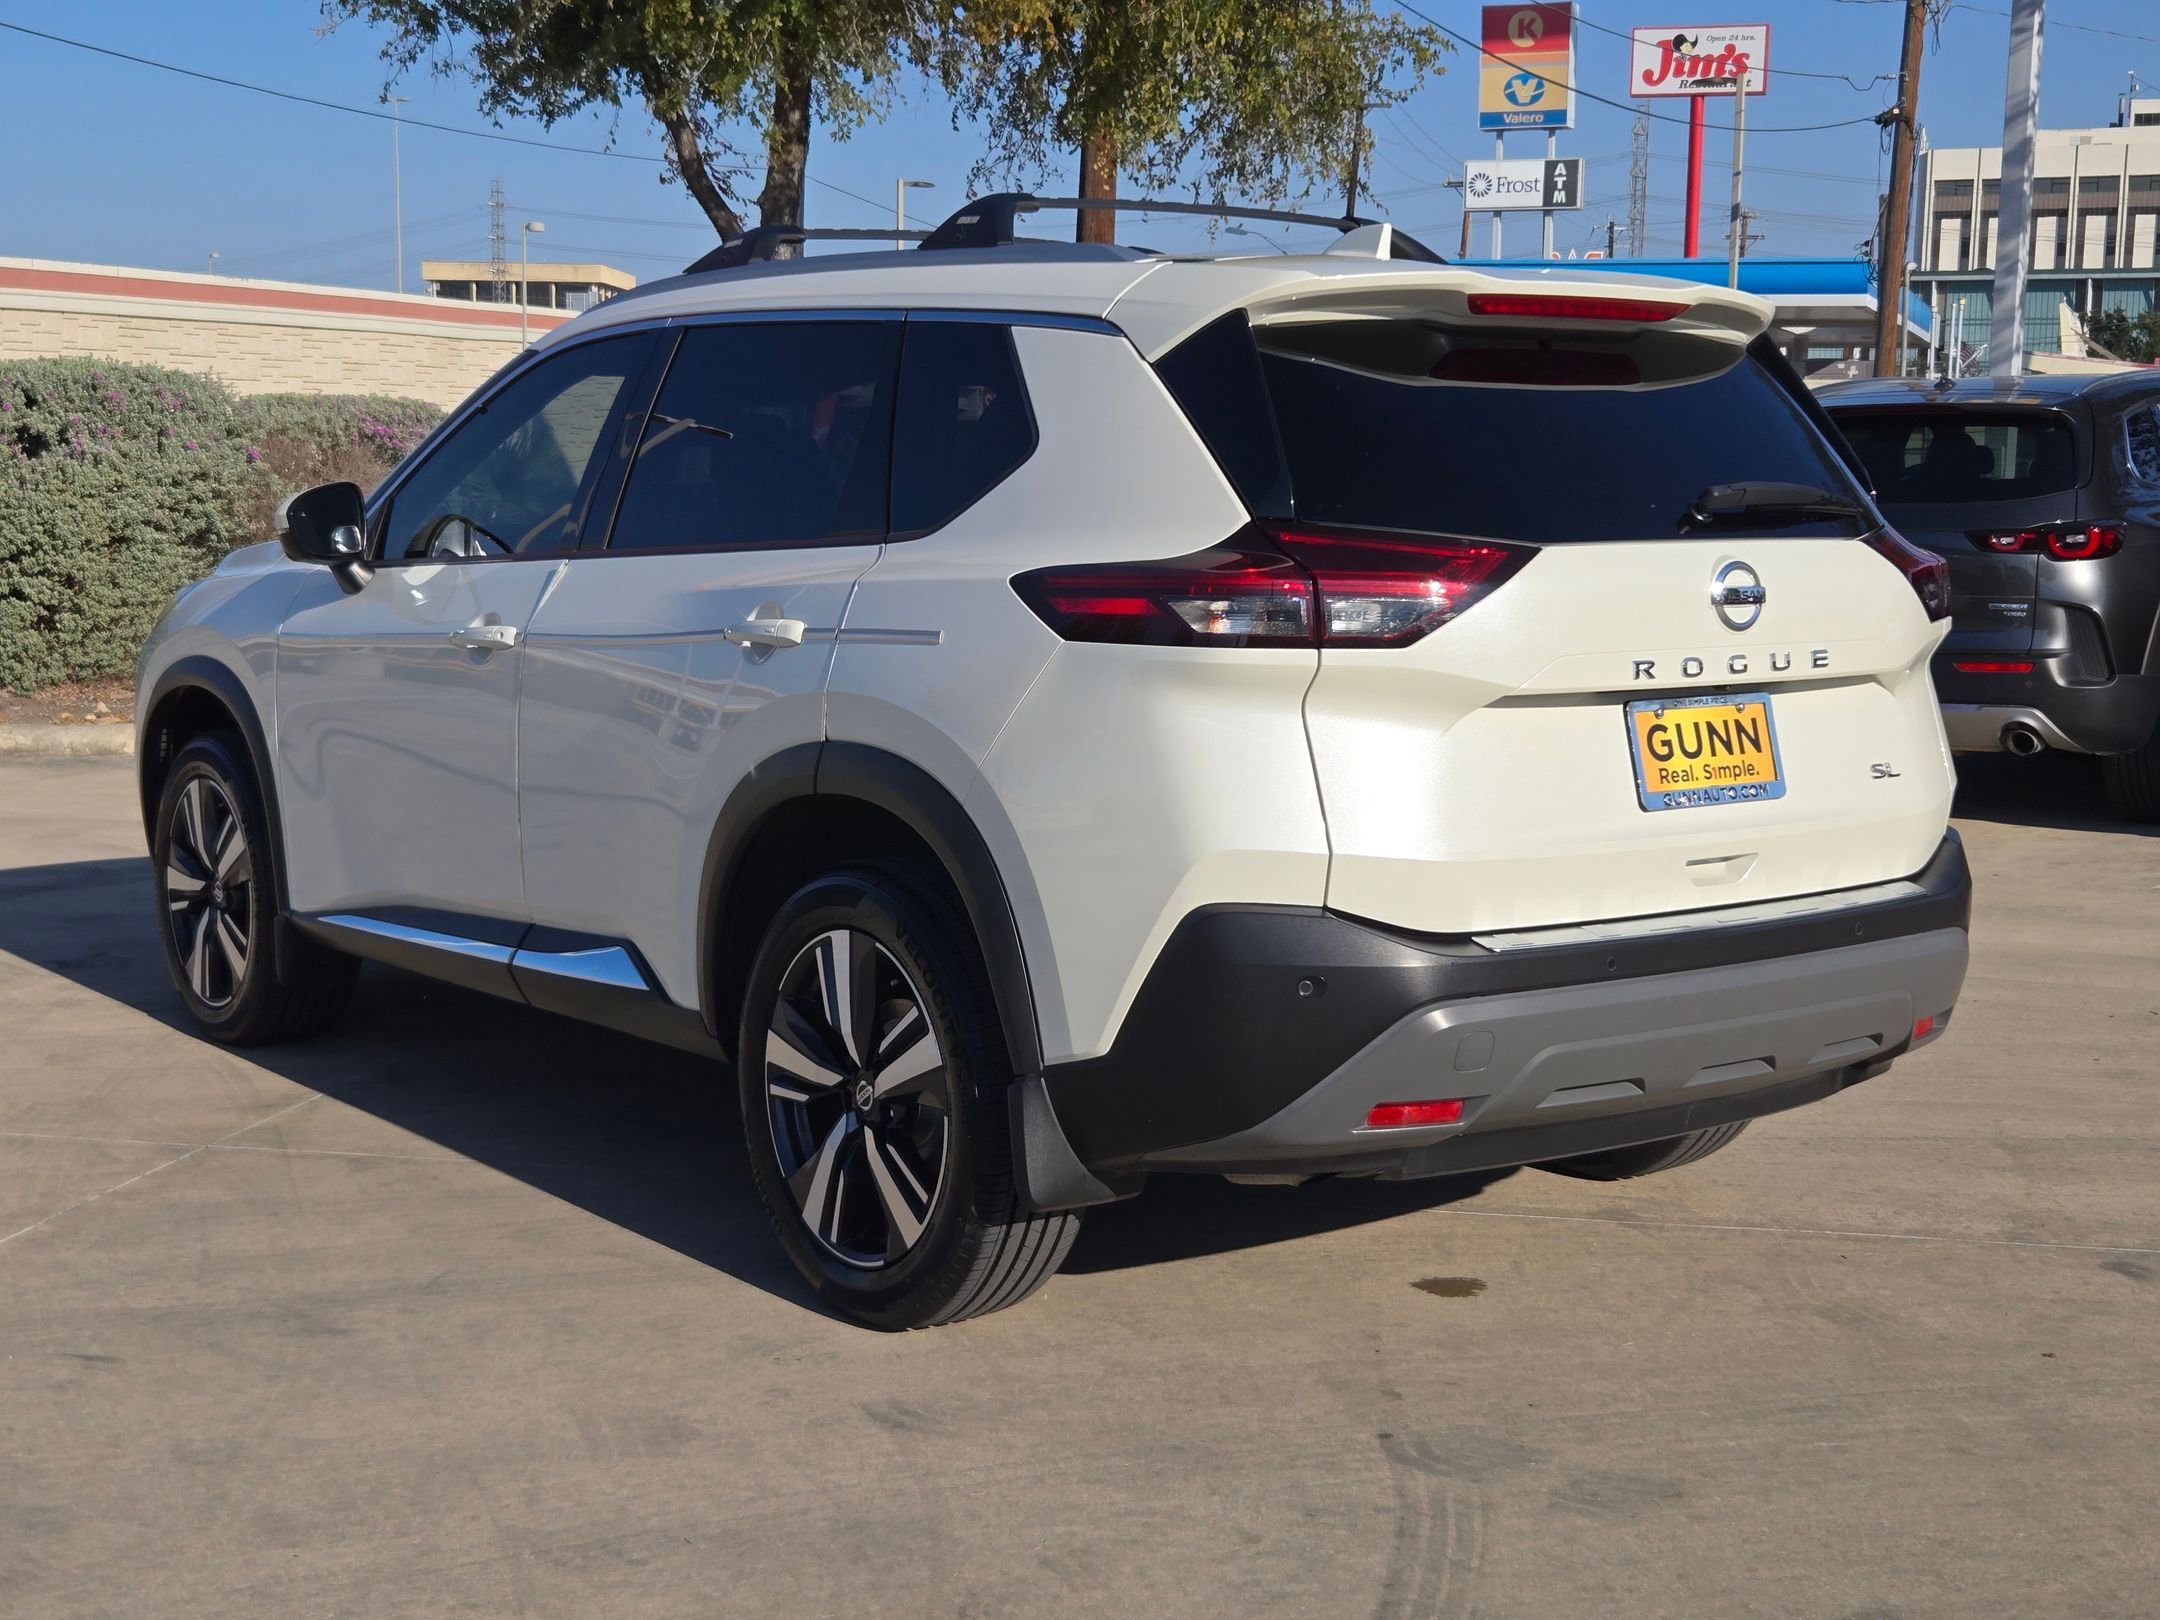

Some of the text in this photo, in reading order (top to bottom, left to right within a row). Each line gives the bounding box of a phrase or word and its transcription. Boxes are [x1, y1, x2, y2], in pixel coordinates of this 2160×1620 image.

[1706, 34, 1727, 43] Open
[1642, 39, 1750, 87] Jim's
[1503, 113, 1544, 124] Valero
[1496, 176, 1541, 193] Frost
[1553, 162, 1567, 204] ATM
[1632, 649, 1830, 680] ROGUE
[1647, 717, 1762, 762] GUNN
[1658, 765, 1699, 785] Real.
[1870, 762, 1901, 780] SL
[1663, 783, 1769, 807] GUNNAUTO.COM
